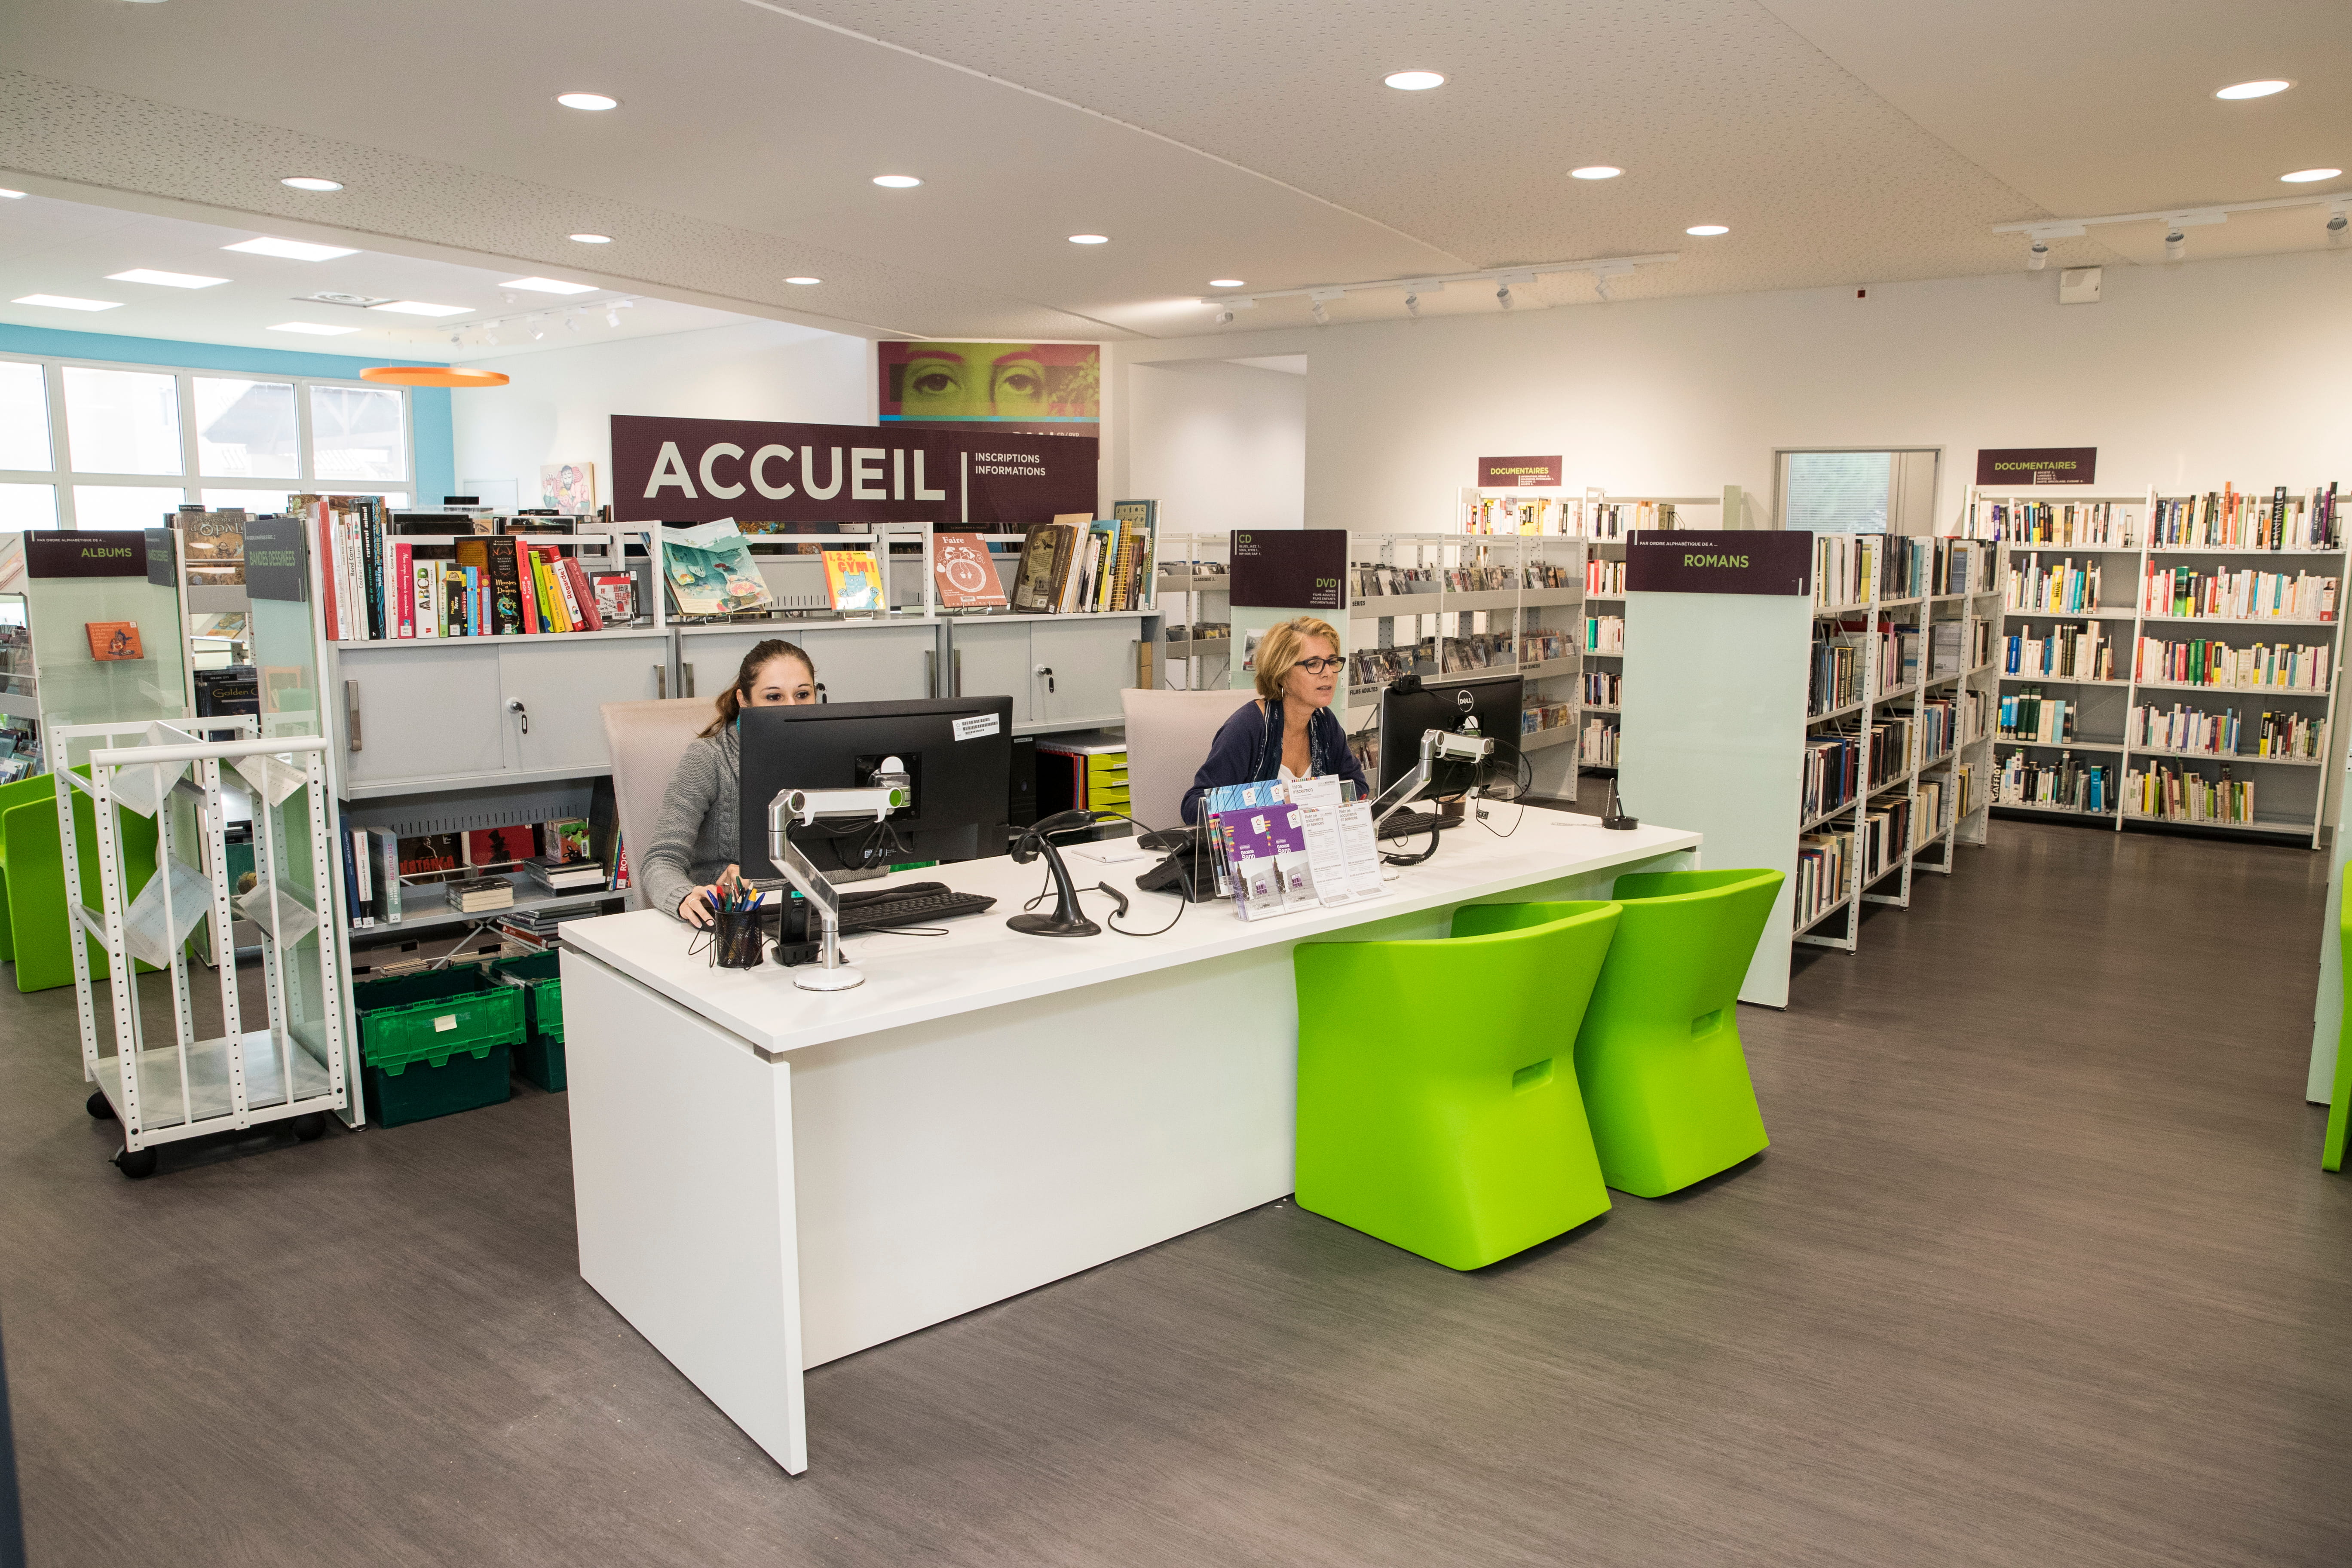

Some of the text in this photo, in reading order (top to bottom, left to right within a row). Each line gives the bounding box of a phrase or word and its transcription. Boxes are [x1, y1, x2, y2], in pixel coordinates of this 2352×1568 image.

[975, 453, 1040, 463] INSCRIPTIONS
[643, 441, 946, 501] ACCUEIL
[975, 466, 1046, 476] INFORMATIONS
[1995, 461, 2076, 470] DOCUMENTAIRES
[2272, 499, 2283, 536] ANIMAL
[1239, 534, 1252, 543] CD
[81, 548, 132, 557] ALBUMS
[1684, 554, 1749, 568] ROMANS
[838, 561, 869, 573] GYM
[417, 568, 430, 610] ABCD
[560, 570, 573, 600] Regarde
[1316, 579, 1336, 588] DVD
[213, 688, 249, 698] Golden
[399, 855, 455, 875] KATANGA
